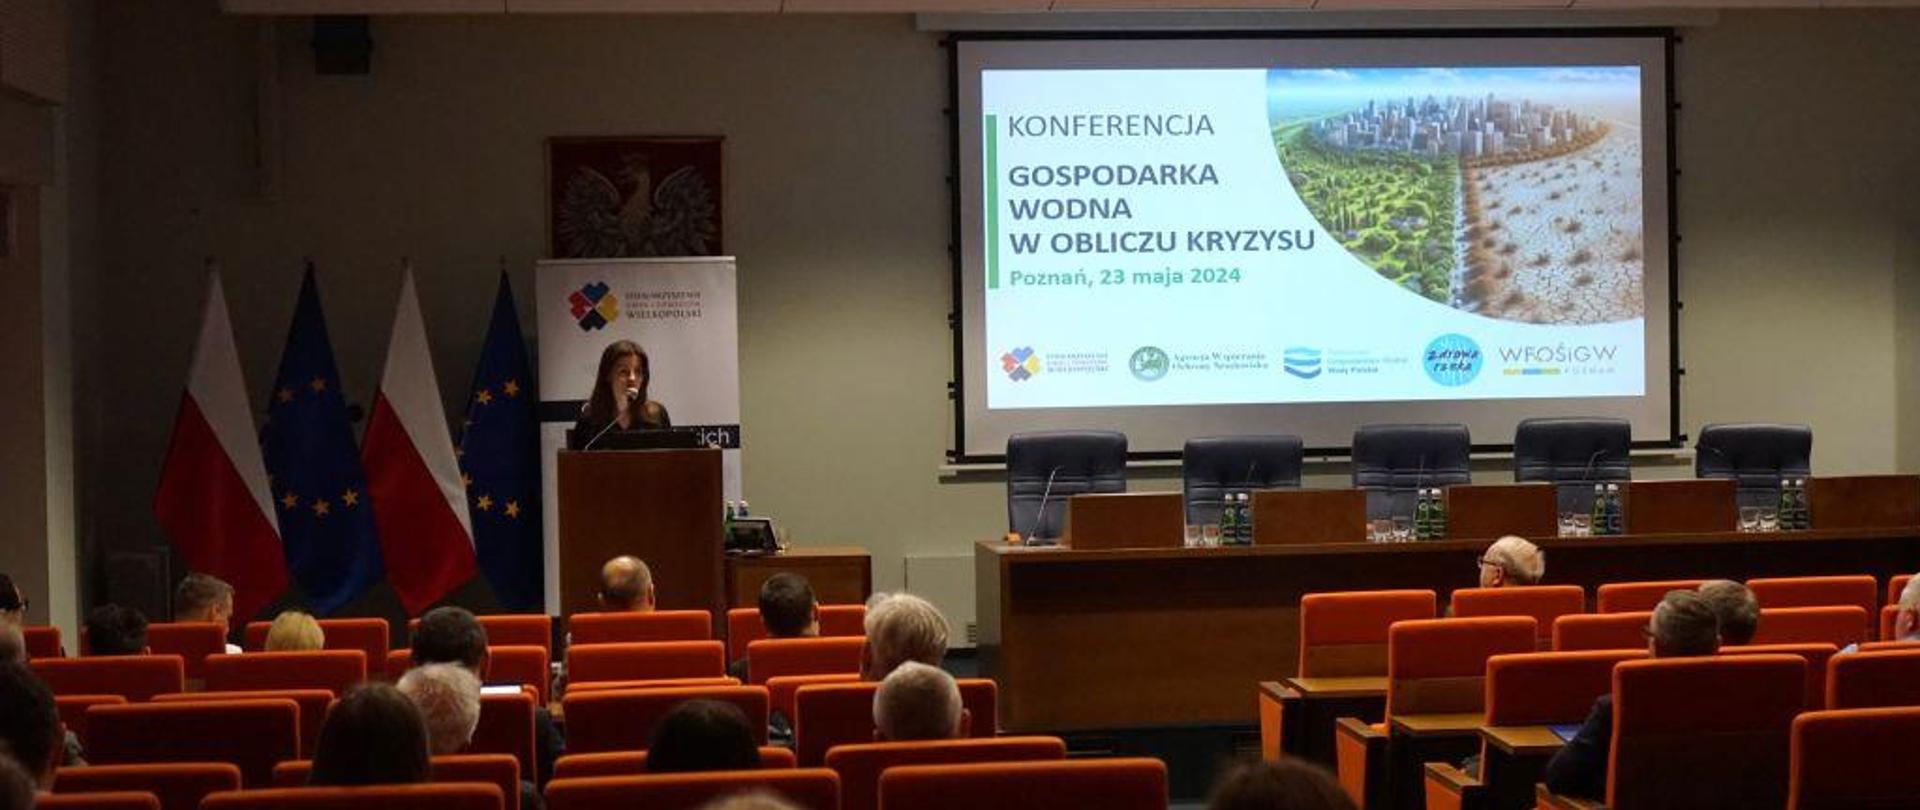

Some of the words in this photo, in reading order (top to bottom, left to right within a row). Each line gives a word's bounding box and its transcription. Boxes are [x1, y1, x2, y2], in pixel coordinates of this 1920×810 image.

[1008, 113, 1215, 137] KONFERENCJA
[1008, 164, 1220, 187] GOSPODARKA
[1008, 198, 1133, 220] WODNA
[1009, 233, 1041, 254] W
[1050, 231, 1177, 253] OBLICZU
[1187, 229, 1316, 251] KRYZYSU
[1010, 268, 1093, 287] Poznań,
[1100, 269, 1125, 285] 23
[1132, 267, 1184, 287] maja
[1190, 267, 1242, 283] 2024
